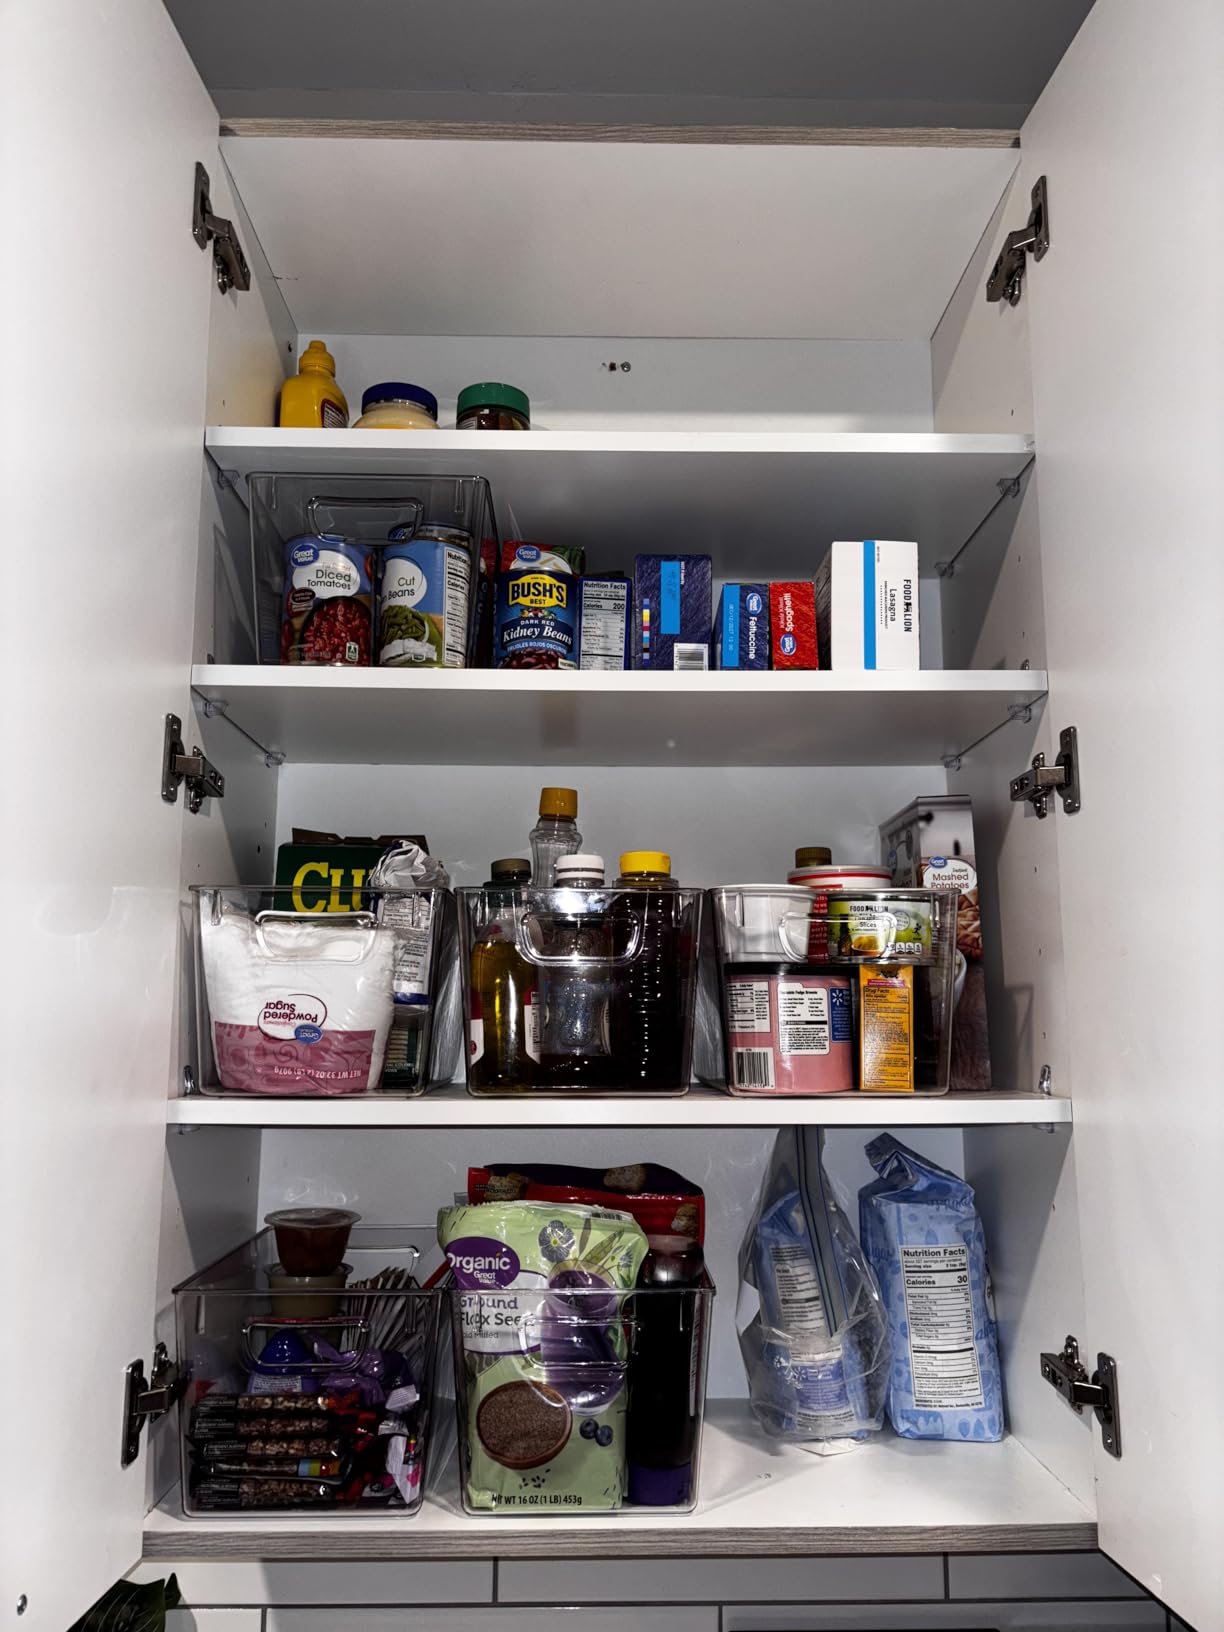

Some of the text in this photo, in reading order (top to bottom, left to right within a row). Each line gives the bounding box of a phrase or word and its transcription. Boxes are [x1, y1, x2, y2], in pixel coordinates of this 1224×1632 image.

[293, 549, 314, 559] Great
[518, 548, 537, 556] Great
[315, 569, 351, 582] Diced
[307, 579, 351, 590] Tomatoes
[397, 576, 416, 587] Cut
[388, 588, 415, 600] Beans
[511, 582, 564, 603] BUSH'S
[888, 588, 898, 622] Lasagna
[903, 579, 912, 632] FOOD LION
[784, 592, 795, 632] Spaghetti
[503, 626, 572, 646] Kidney Beans
[748, 616, 758, 660] Fettuccine
[932, 873, 969, 881] Mashed
[264, 1000, 296, 1012] Sugar
[263, 1011, 318, 1023] Powdered
[300, 1032, 319, 1040] Great
[274, 1066, 293, 1075] 907g
[316, 1070, 327, 1079] OZ
[337, 1070, 348, 1079] WT
[350, 1069, 362, 1079] NET
[903, 1248, 966, 1257] Nutrition Facts
[446, 1252, 511, 1274] Organic
[473, 1271, 496, 1279] Great
[957, 1275, 968, 1283] 30
[460, 1295, 518, 1310] Ground
[494, 1313, 526, 1326] See
[504, 1495, 516, 1504] WT
[518, 1495, 528, 1504] 16
[528, 1495, 539, 1504] OZ
[539, 1494, 547, 1504] (1
[549, 1494, 562, 1504] LB)
[563, 1494, 583, 1505] 453g
